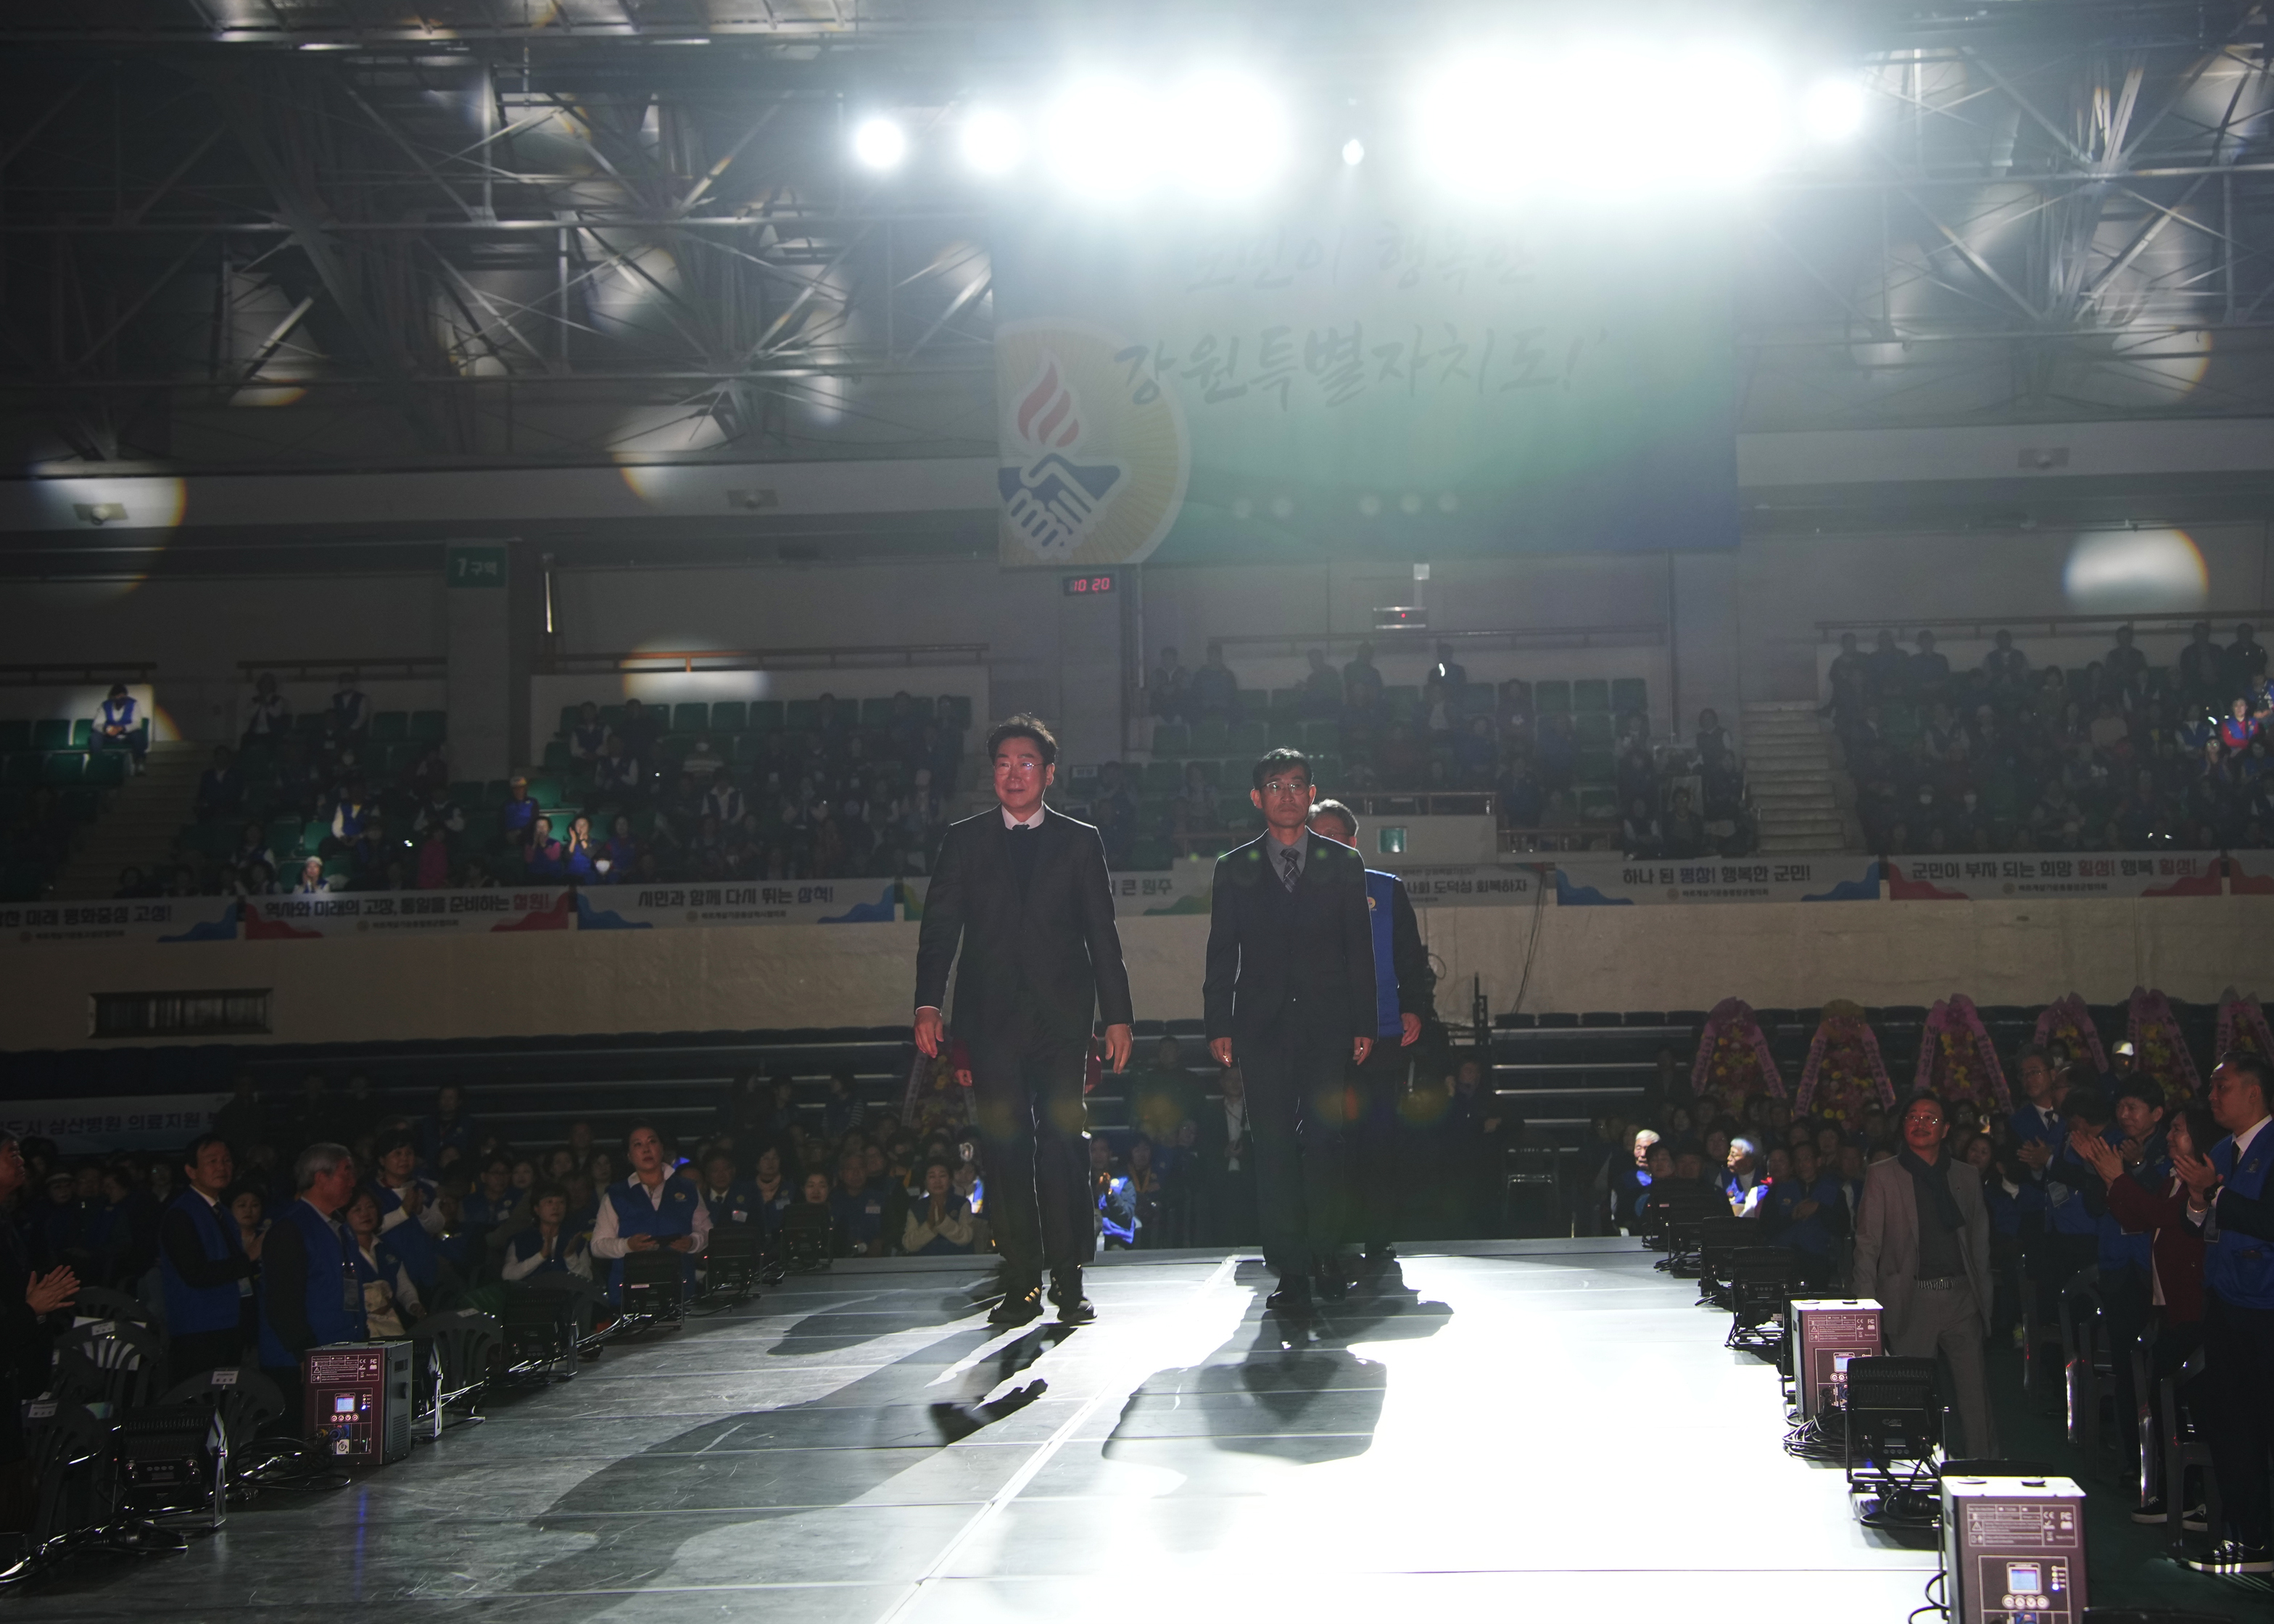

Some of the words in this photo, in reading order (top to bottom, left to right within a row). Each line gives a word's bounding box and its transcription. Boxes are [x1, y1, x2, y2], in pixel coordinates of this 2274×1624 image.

[1376, 219, 1537, 295] 행복한
[1623, 869, 1654, 884] 하나
[1659, 868, 1674, 884] 된
[1679, 867, 1716, 883] 평창!
[1721, 865, 1769, 882] 행복한
[1774, 864, 1811, 882] 군민!
[1912, 862, 1959, 879] 군민이
[1966, 861, 1998, 878] 부자
[2004, 861, 2035, 878] 되는
[2041, 861, 2072, 877] 희망
[2122, 858, 2153, 876] 행복
[638, 890, 685, 908] 시민과
[689, 889, 722, 907] 함께
[726, 888, 756, 906] 다시
[761, 887, 793, 905] 뛰는
[797, 886, 834, 904] 삼척!
[1121, 879, 1136, 895] 큰
[1142, 879, 1173, 895] 원주
[1434, 880, 1472, 894] 도덕성
[1476, 879, 1527, 892] 회복하자
[26, 908, 59, 926] 미래
[65, 906, 128, 924] 평화중심
[133, 905, 172, 922] 고성!
[265, 900, 311, 918] 역사와
[314, 899, 360, 916] 미래의
[364, 898, 397, 916] 고장,
[400, 897, 446, 914] 통일을
[450, 895, 510, 913] 준비하는
[513, 892, 550, 911] 철원!
[49, 1115, 121, 1135] 삼산병원
[128, 1111, 200, 1131] 의료지원
